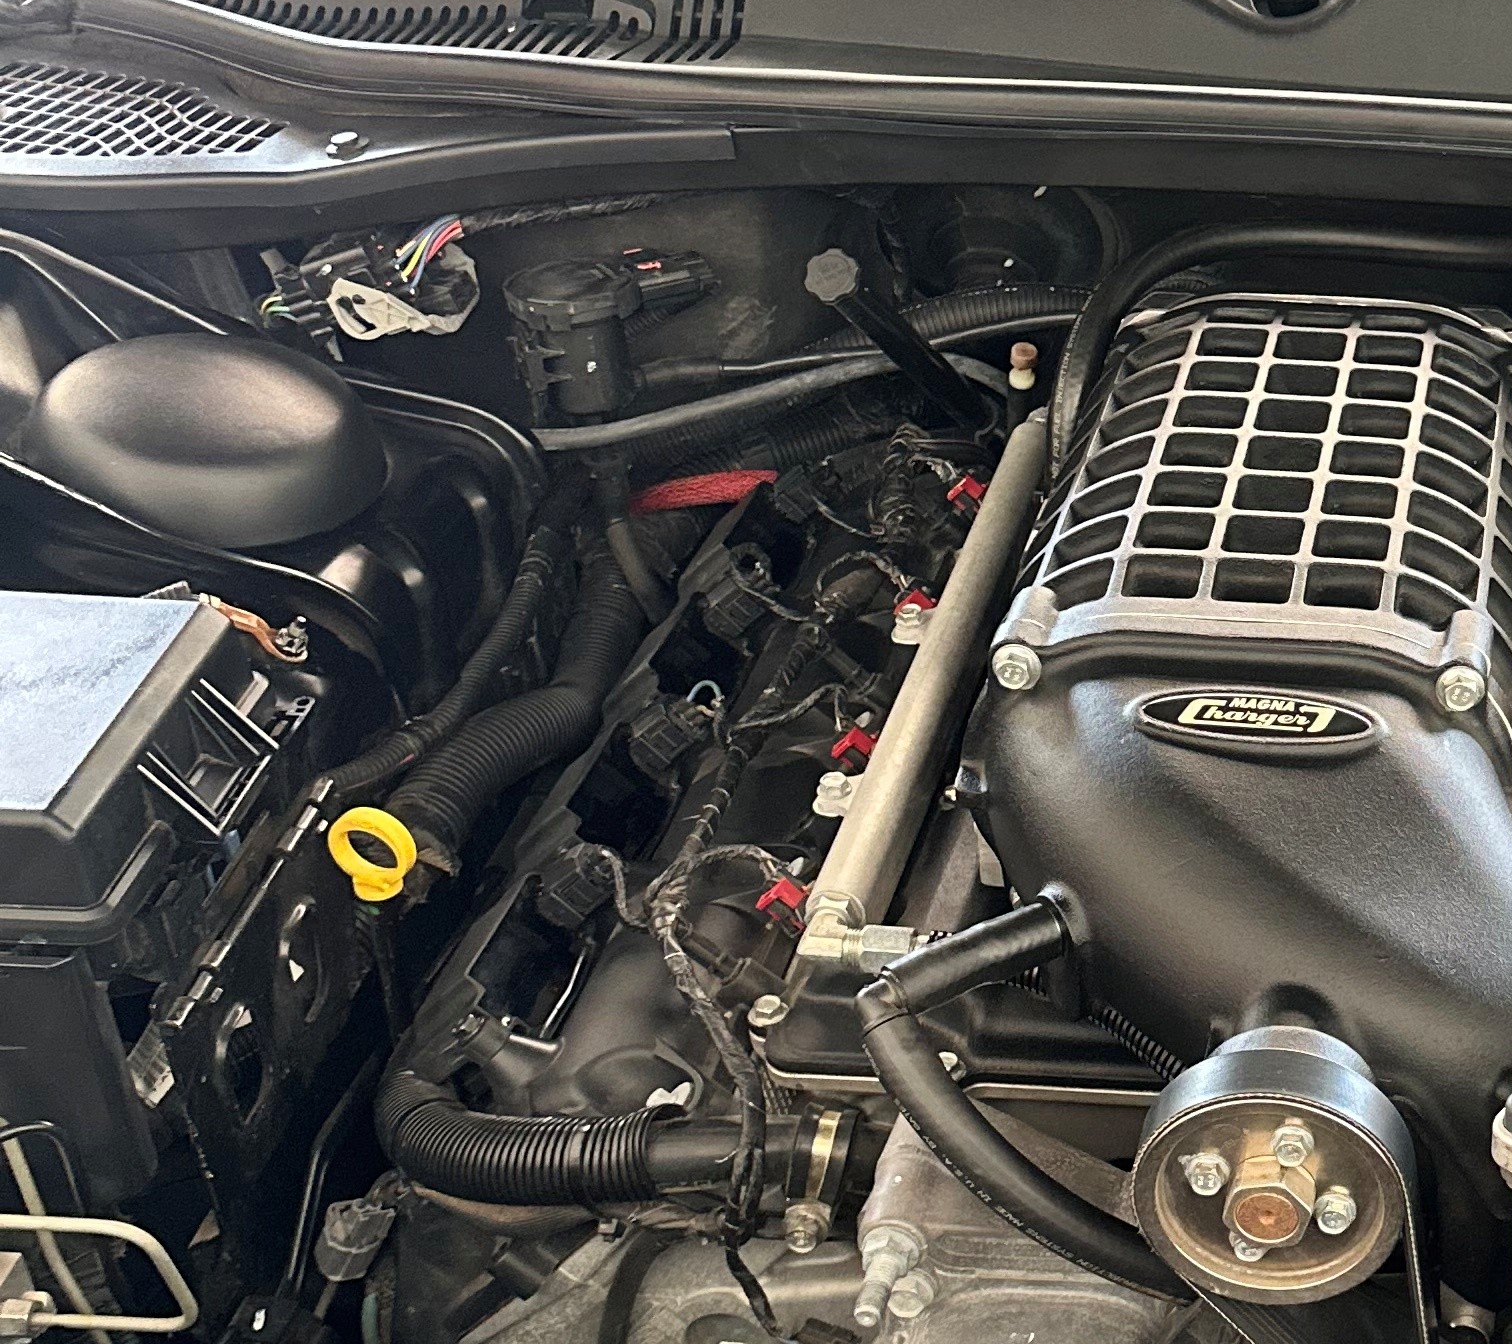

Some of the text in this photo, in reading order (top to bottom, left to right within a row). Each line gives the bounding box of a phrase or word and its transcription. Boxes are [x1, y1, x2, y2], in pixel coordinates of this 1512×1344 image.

[1055, 352, 1071, 404] INJECTION
[1052, 438, 1060, 458] FOR
[1228, 696, 1295, 712] MAGNA
[1178, 698, 1336, 733] Charger
[922, 1133, 937, 1150] BY
[974, 1188, 993, 1204] IN
[993, 1203, 1025, 1229] MADE
